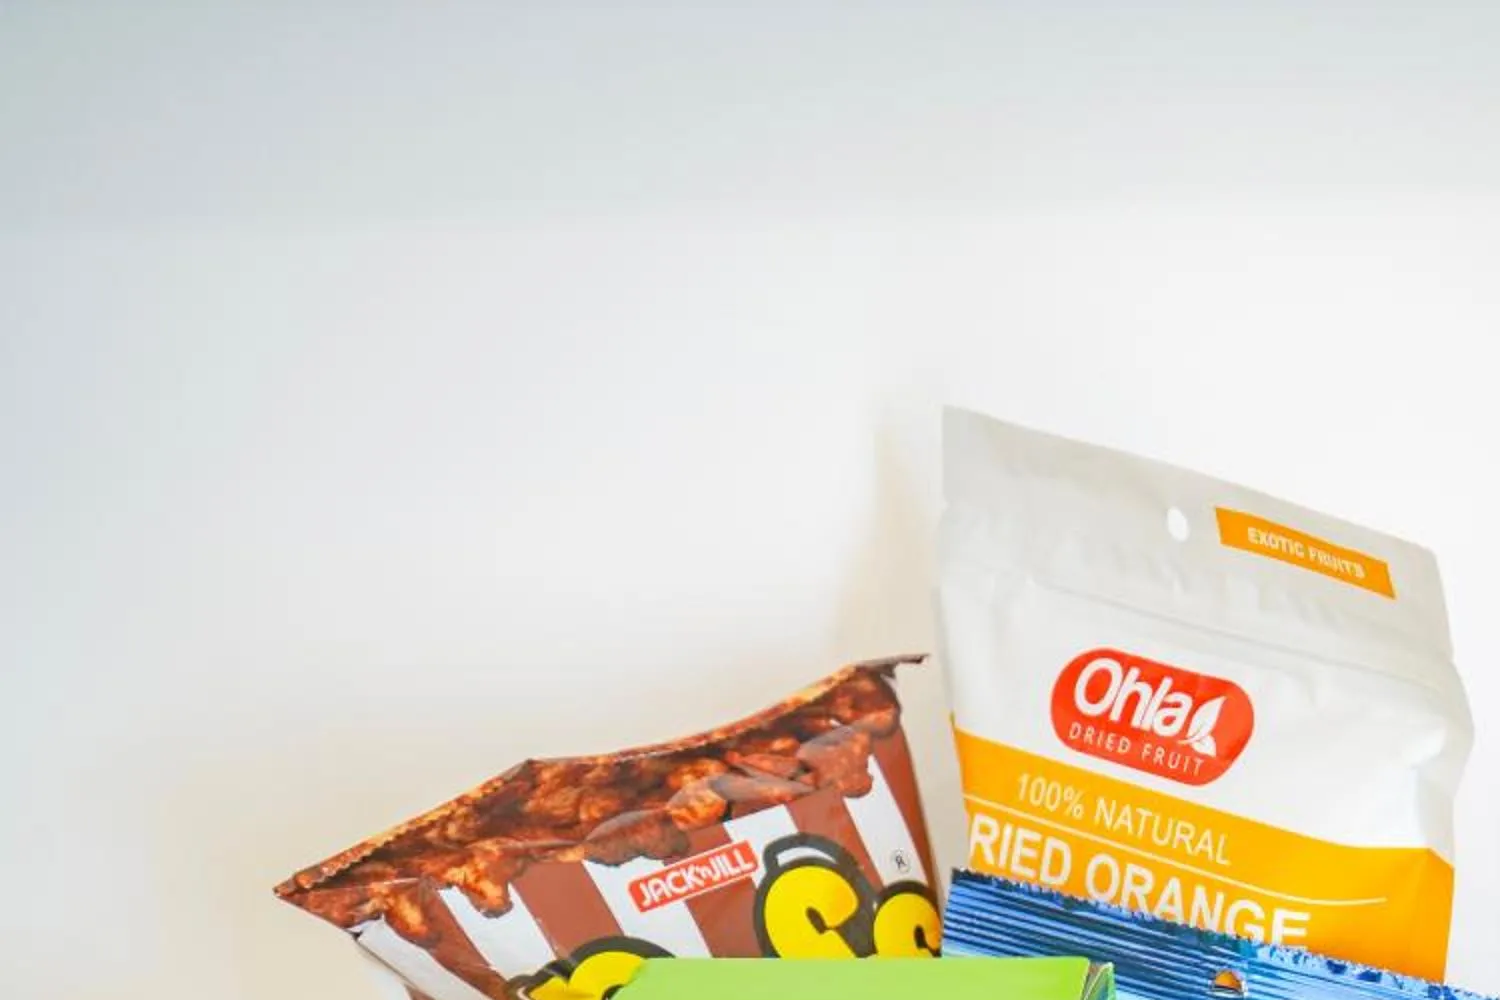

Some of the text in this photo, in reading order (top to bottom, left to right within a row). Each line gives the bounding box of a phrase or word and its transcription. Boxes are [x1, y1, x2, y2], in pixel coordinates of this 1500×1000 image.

[1247, 527, 1366, 579] EXOTIC FRUITS
[1074, 657, 1193, 737] Ohla
[1068, 722, 1204, 776] DRIED FRUIT
[1017, 772, 1232, 866] 100% NATURAL
[1085, 853, 1311, 951] ORANGE
